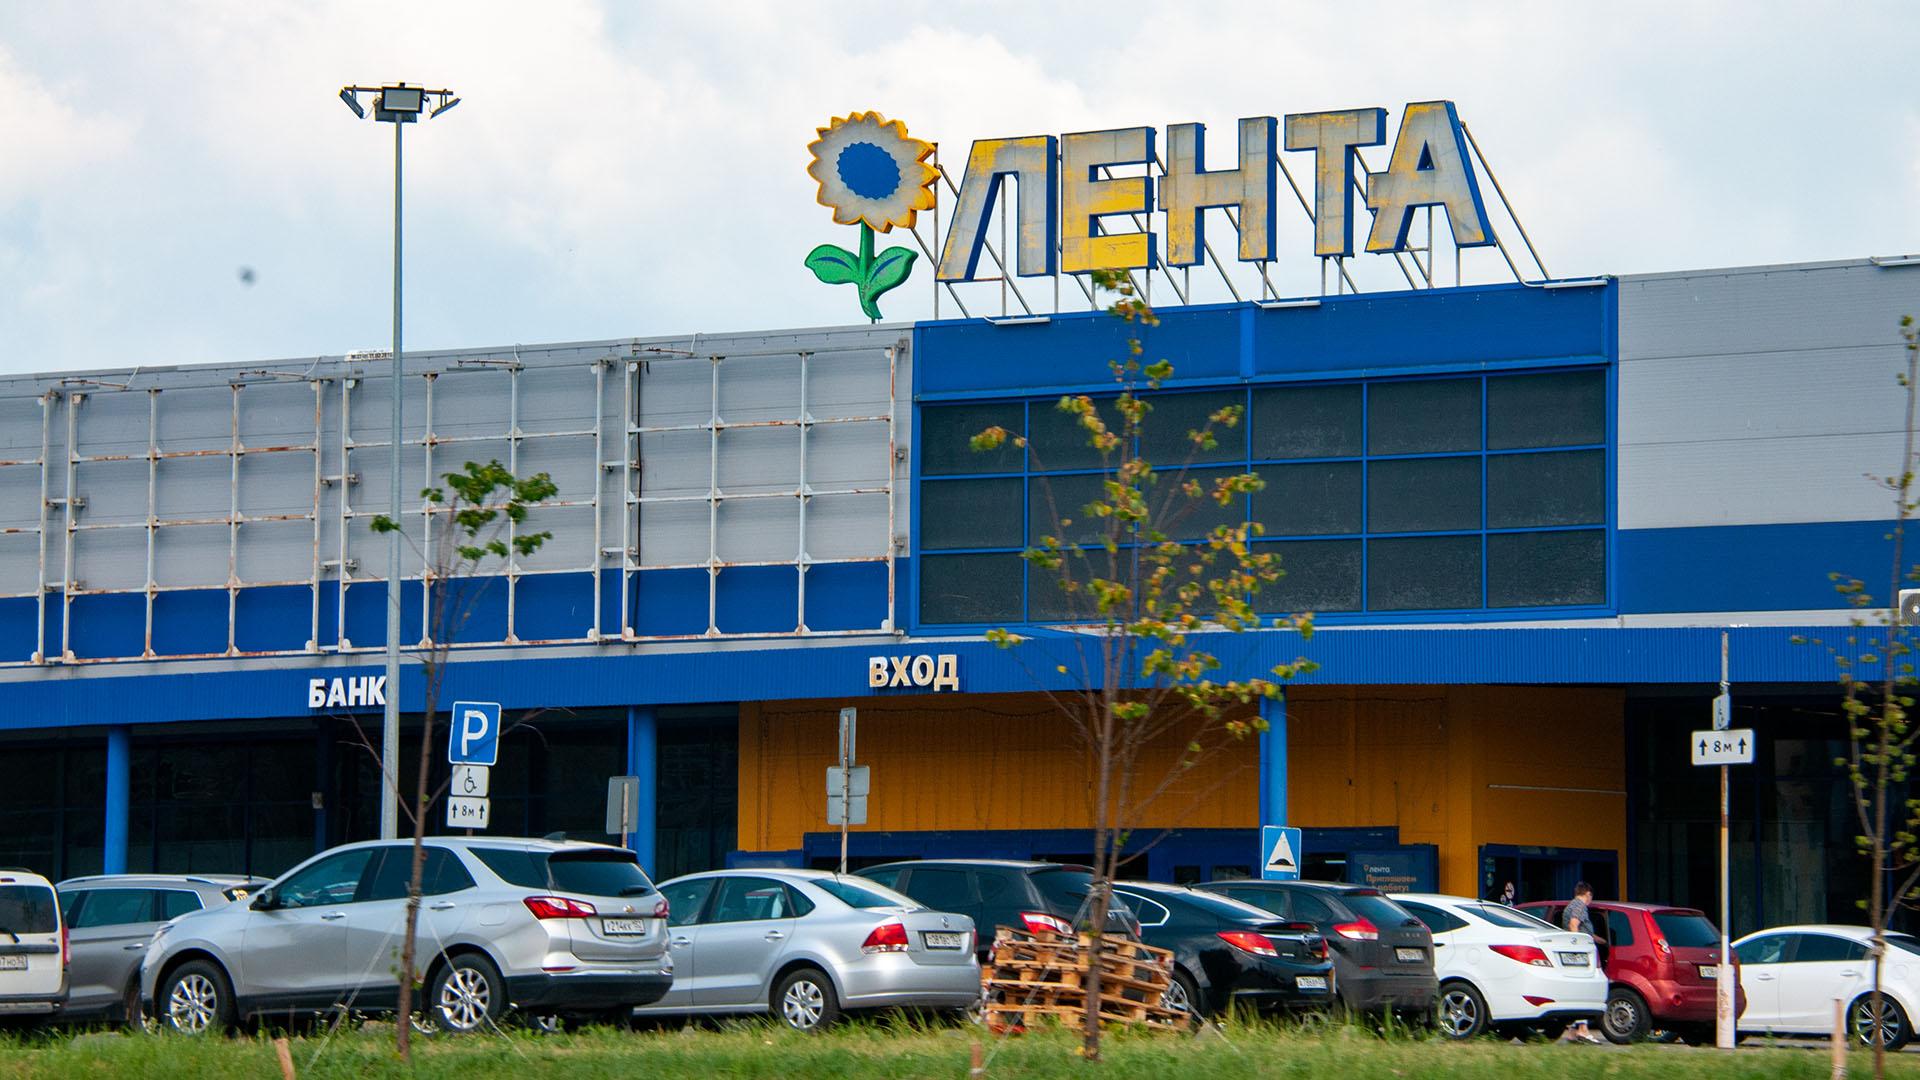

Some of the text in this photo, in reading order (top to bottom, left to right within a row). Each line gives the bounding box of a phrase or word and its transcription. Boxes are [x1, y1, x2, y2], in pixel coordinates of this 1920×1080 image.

[935, 100, 1496, 283] ЛЕНТА
[308, 675, 387, 708] БАНК
[869, 654, 959, 692] ВХОД
[461, 710, 489, 756] P
